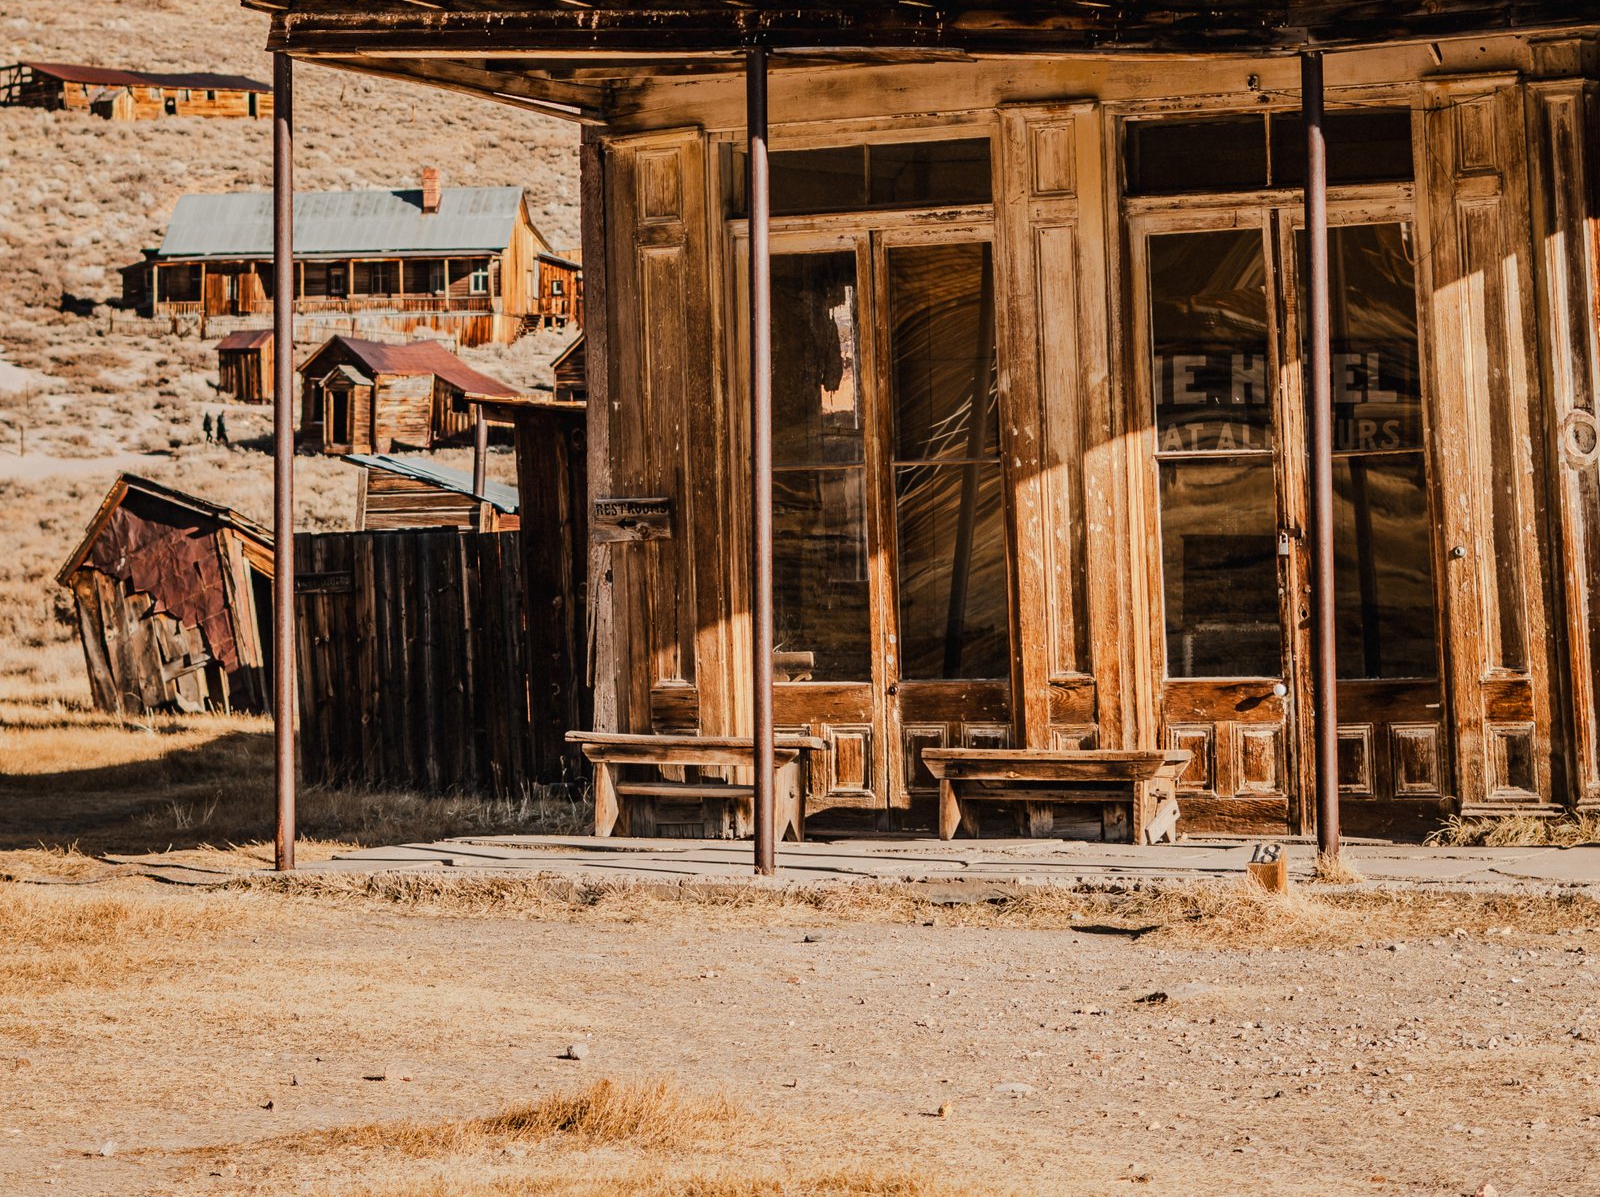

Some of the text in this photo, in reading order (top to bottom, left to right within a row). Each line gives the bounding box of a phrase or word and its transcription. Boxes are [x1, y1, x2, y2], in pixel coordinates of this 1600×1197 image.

[1231, 352, 1397, 405] HEL
[1162, 422, 1204, 451] AT
[595, 502, 668, 516] RESTROOMS
[1251, 843, 1281, 864] 18
